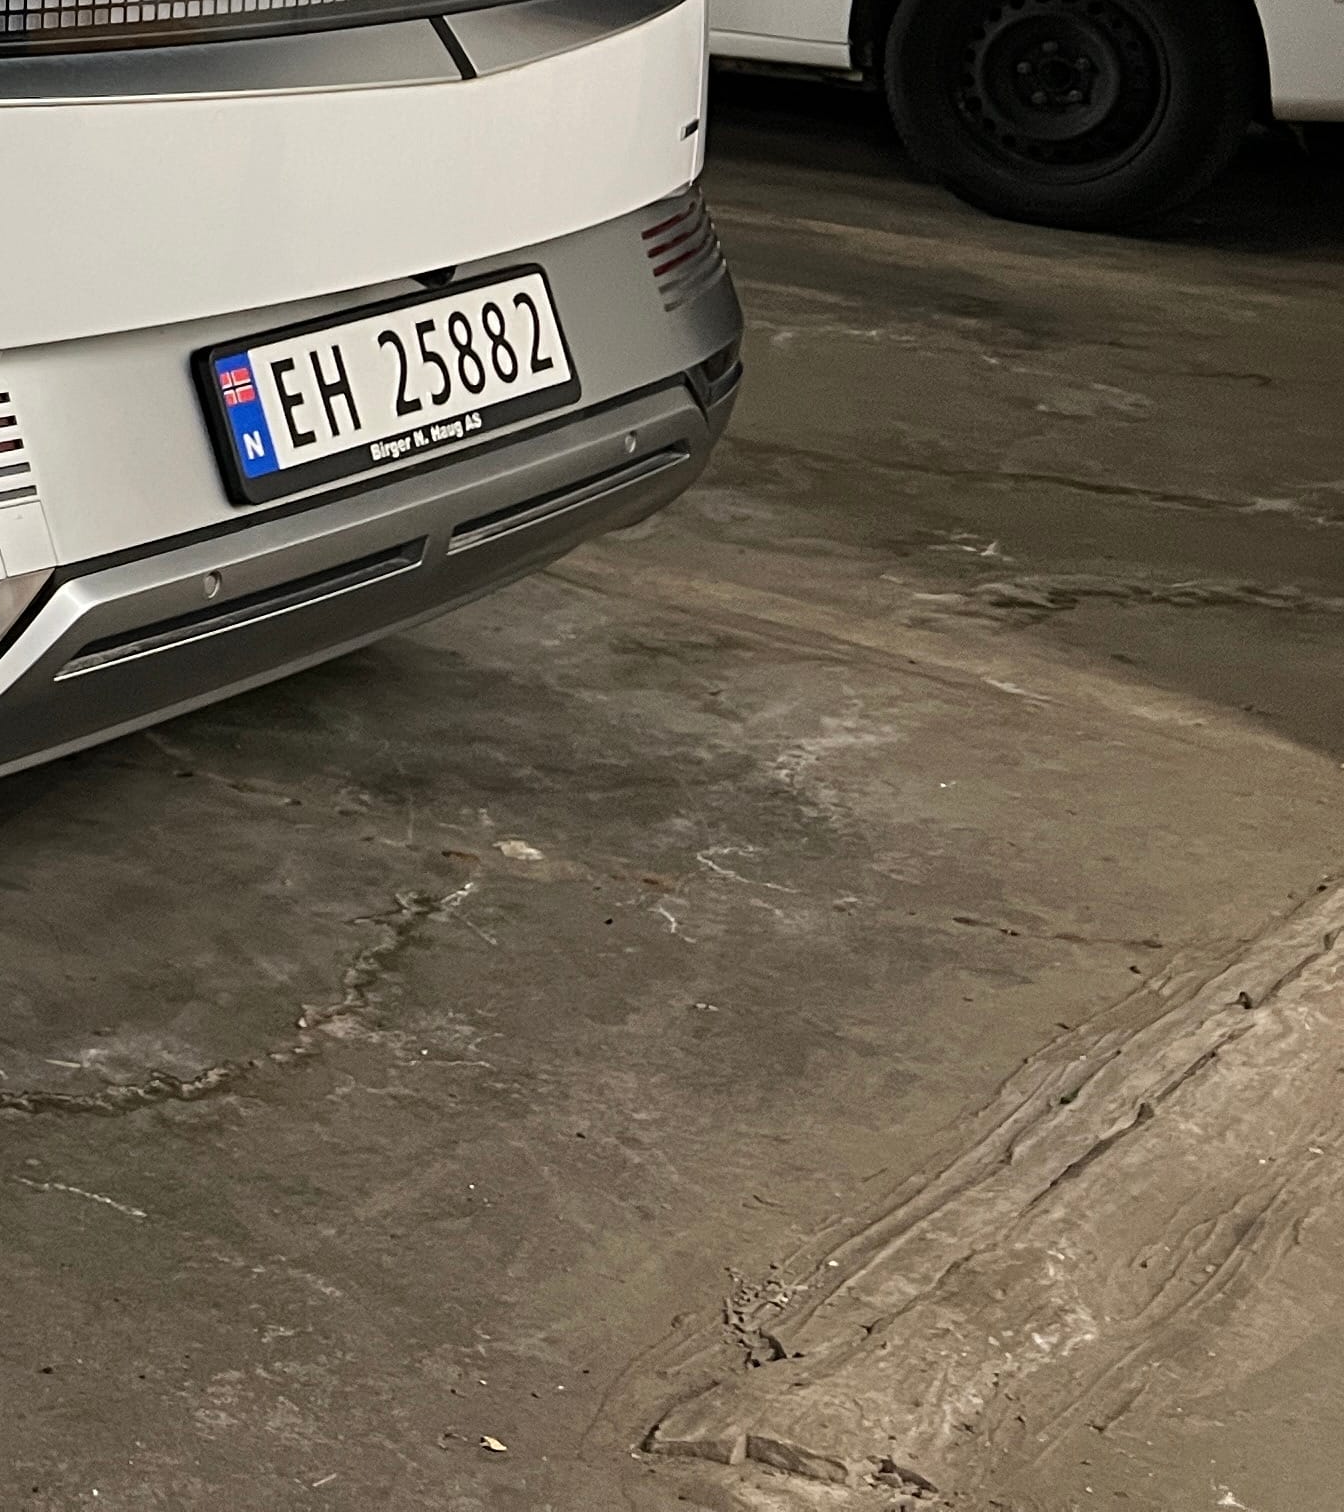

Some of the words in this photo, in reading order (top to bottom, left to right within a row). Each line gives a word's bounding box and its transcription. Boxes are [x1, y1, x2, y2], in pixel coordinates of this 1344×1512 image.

[270, 345, 362, 449] EH
[377, 292, 554, 417] 25882
[242, 430, 266, 461] N
[370, 436, 411, 461] Birger
[430, 420, 464, 442] Haug
[465, 411, 482, 431] AS
